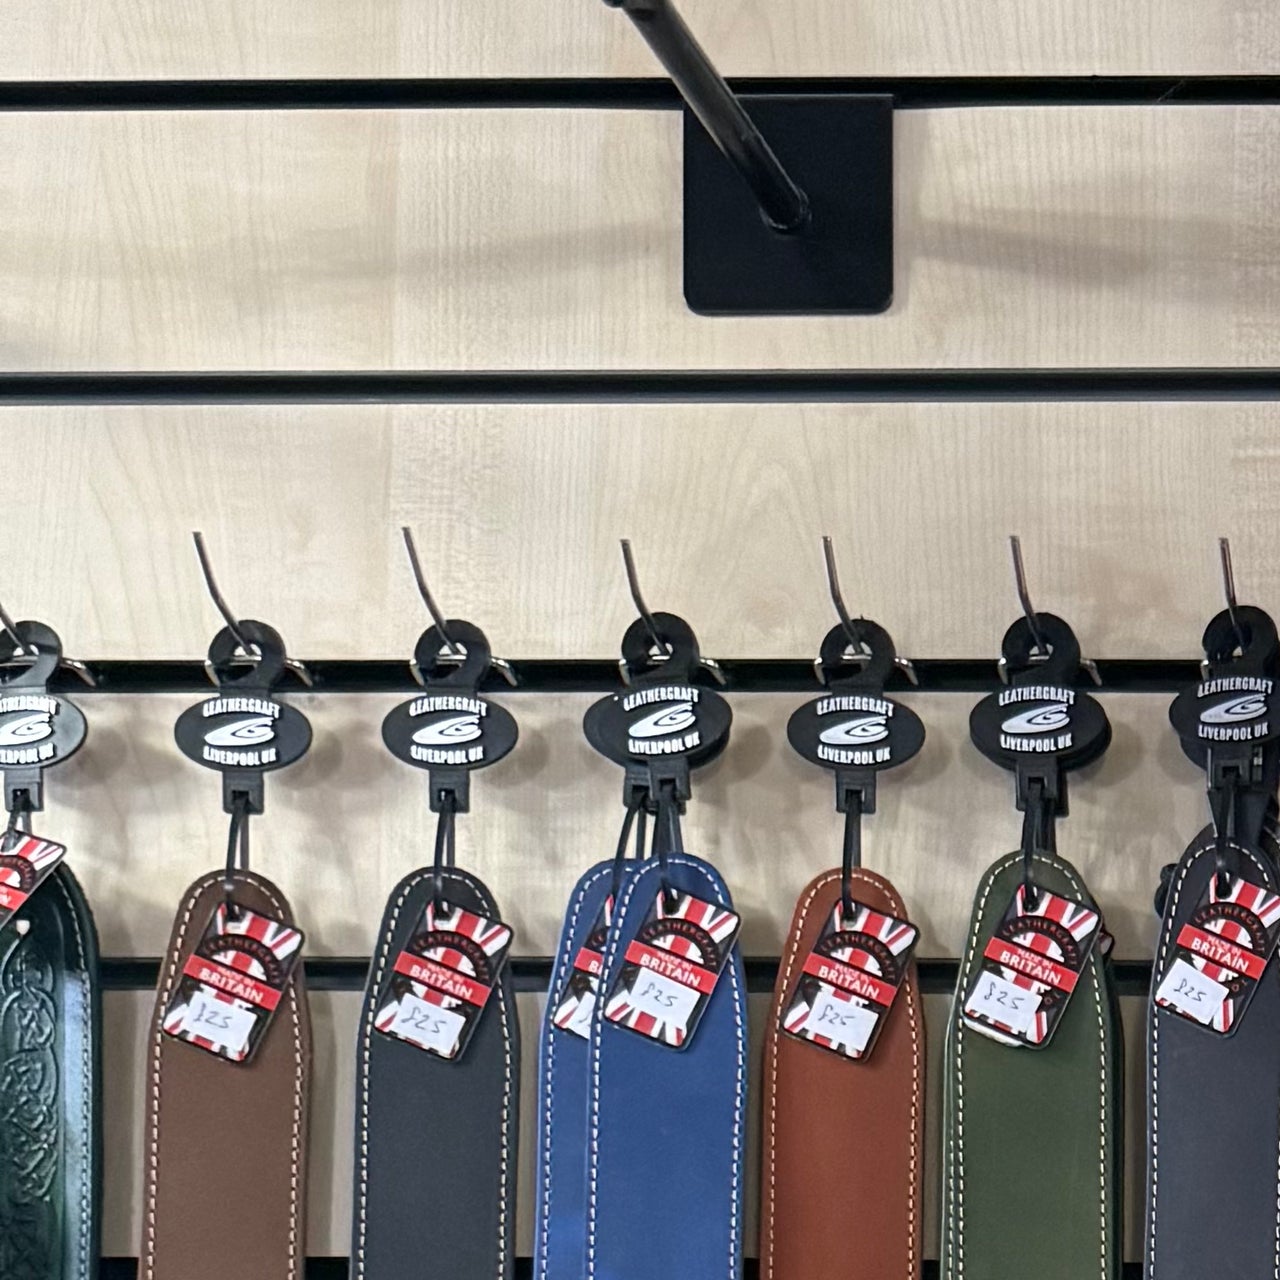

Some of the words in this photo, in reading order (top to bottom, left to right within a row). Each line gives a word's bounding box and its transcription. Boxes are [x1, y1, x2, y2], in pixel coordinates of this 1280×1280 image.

[623, 686, 699, 711] LEATHERCRAFT
[999, 686, 1075, 706] LEATHERCRAFT
[1197, 677, 1273, 698] LEATHERCRAFT
[816, 696, 894, 717] LEATHERCRAFT
[628, 739, 685, 754] LIVERPOOL
[684, 731, 700, 749] UK
[1000, 733, 1056, 752] LIVERPOOL
[1058, 733, 1072, 748] UK
[1198, 725, 1252, 741] LIVERPOOL
[1254, 722, 1268, 738] UK
[817, 744, 875, 764] LIVERPOOL
[876, 747, 890, 762] UK
[1000, 950, 1062, 985] BRITAIN
[1191, 938, 1249, 973] BRITAIN
[410, 964, 473, 999] BRITAIN
[639, 953, 701, 987] BRITAIN
[818, 965, 880, 1000] BRITAIN
[200, 967, 263, 1003] BRITAIN
[641, 982, 678, 1007] £25
[984, 981, 1025, 1012] £25
[1173, 977, 1209, 1003] £25
[194, 1002, 232, 1029] £25
[401, 1006, 447, 1034] £25
[818, 1004, 856, 1026] £25
